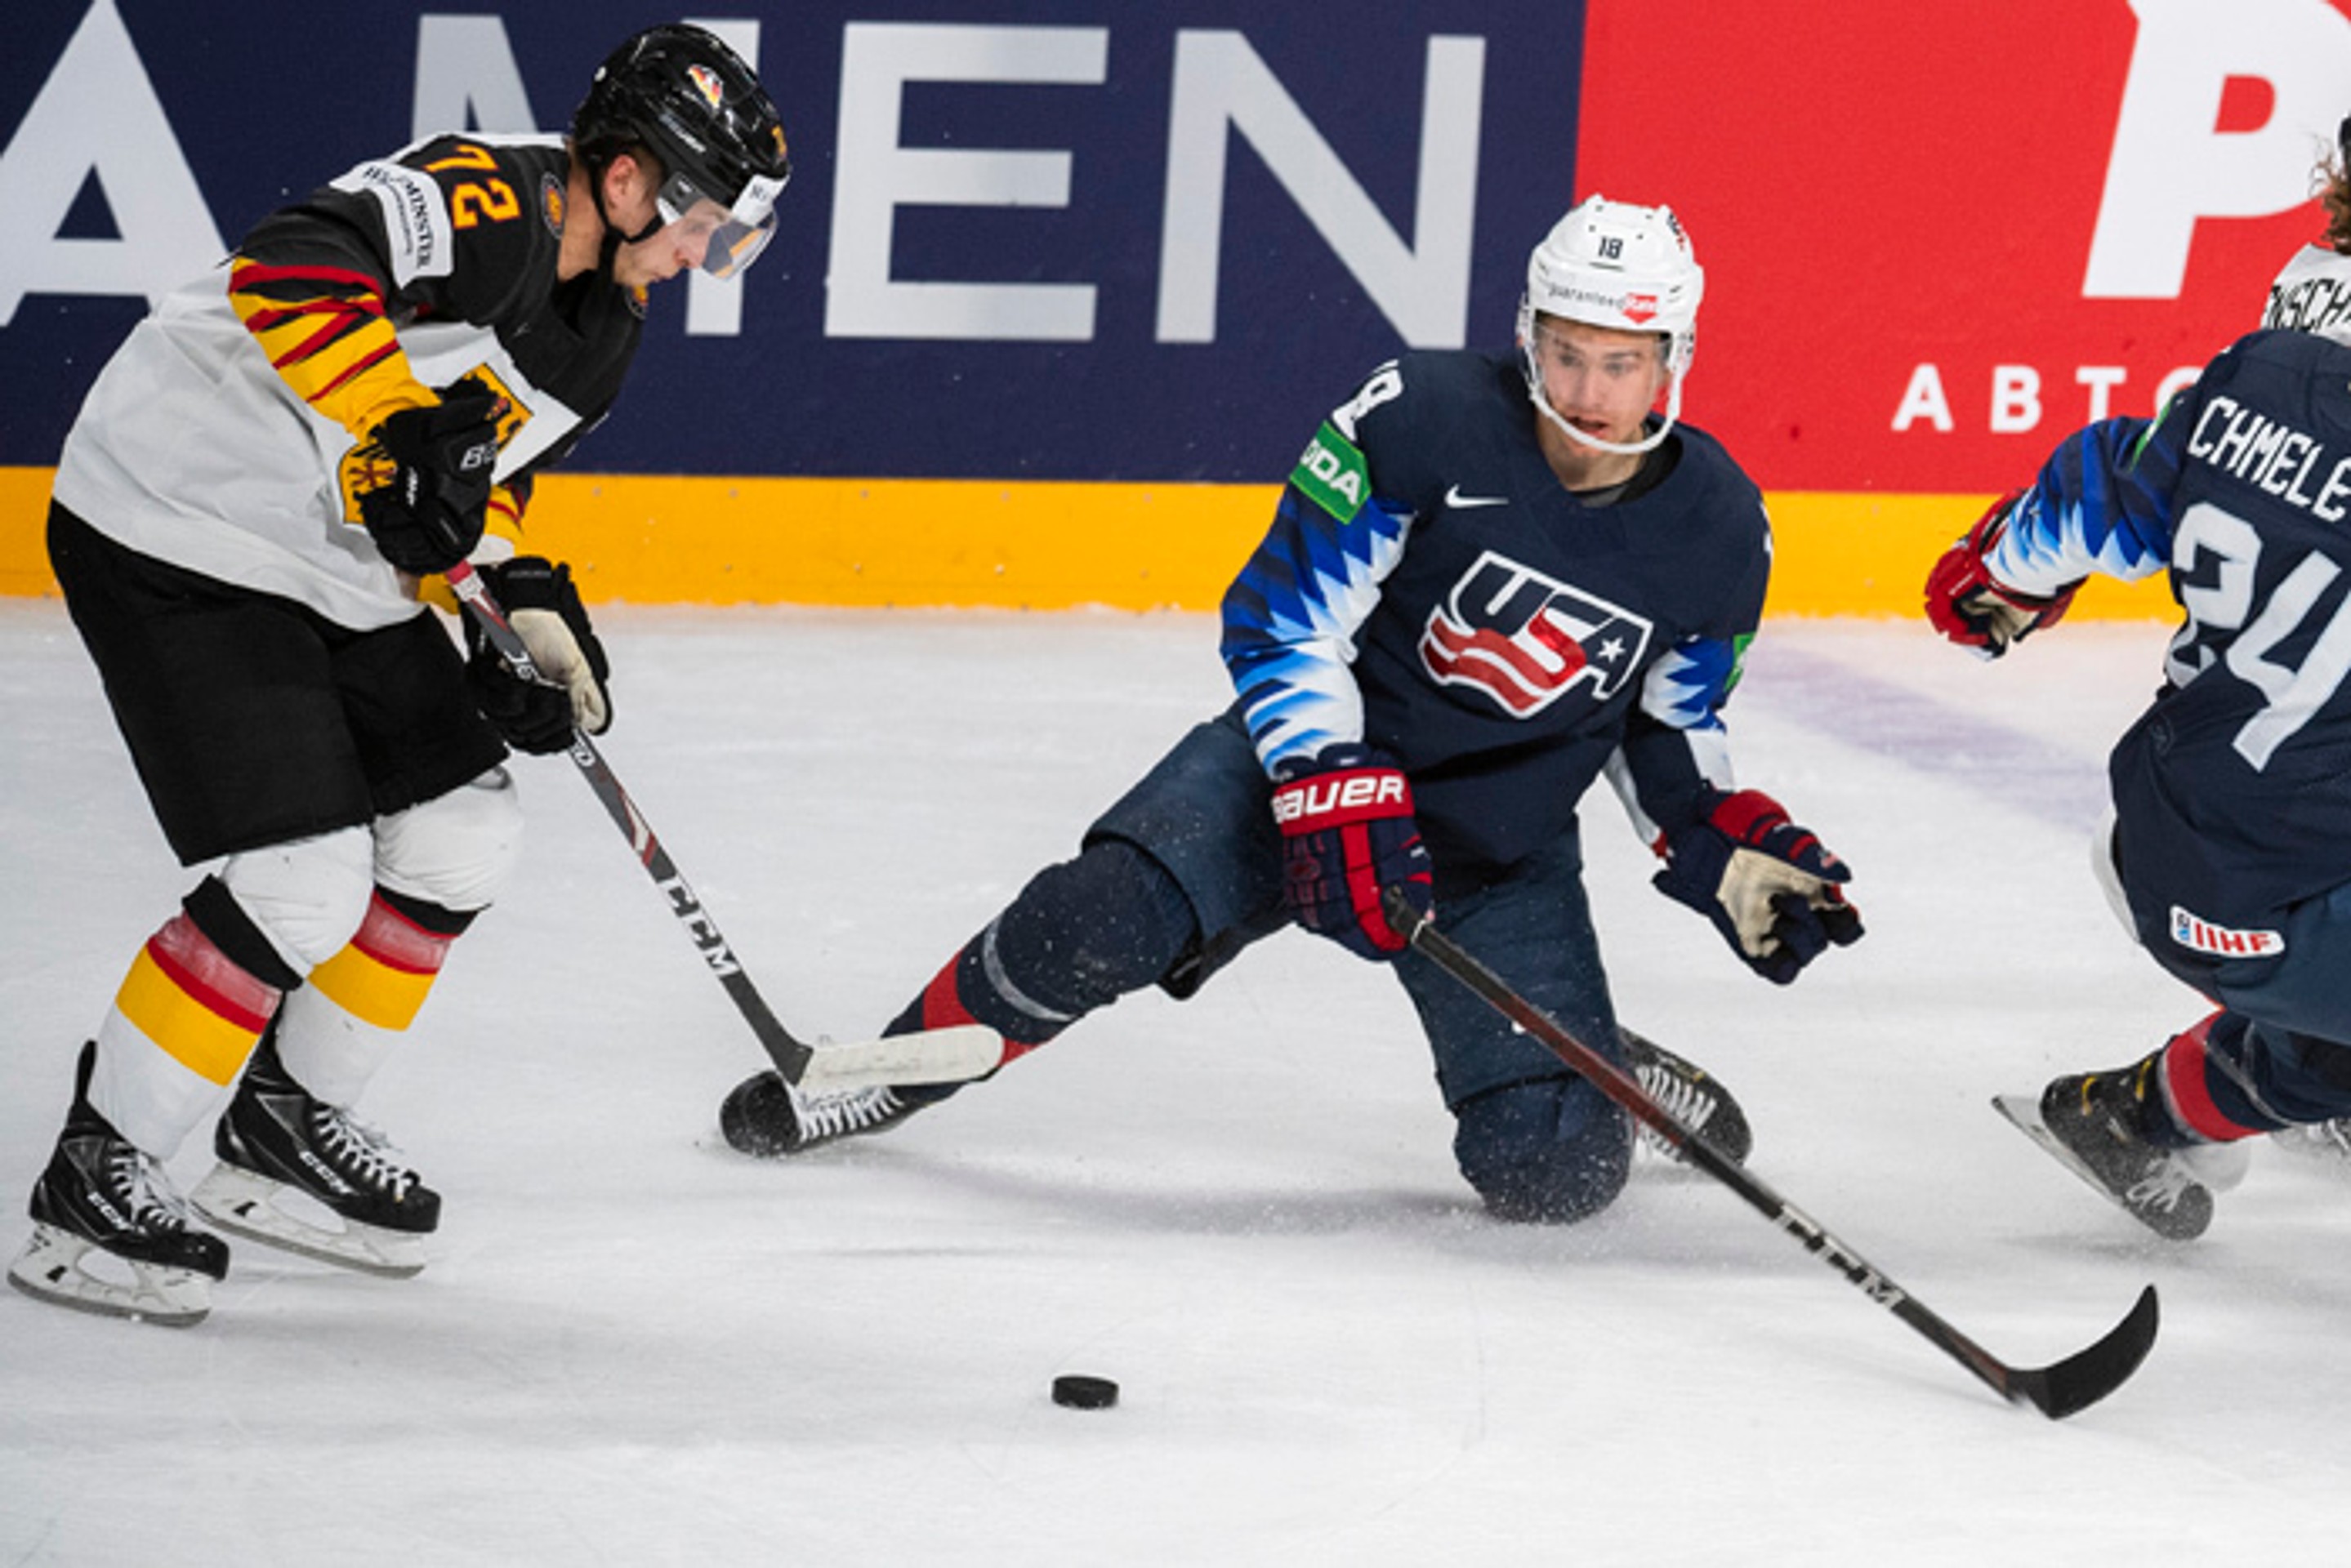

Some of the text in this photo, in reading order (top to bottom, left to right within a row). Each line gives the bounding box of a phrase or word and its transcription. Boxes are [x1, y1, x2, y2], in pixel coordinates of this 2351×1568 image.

[423, 144, 521, 229] 72
[1598, 235, 1624, 260] 18
[1418, 550, 1654, 719] USA
[2164, 502, 2351, 773] 24
[656, 874, 741, 977] CCM
[2194, 920, 2271, 955] IIHF
[1773, 1205, 1905, 1312] CCM
